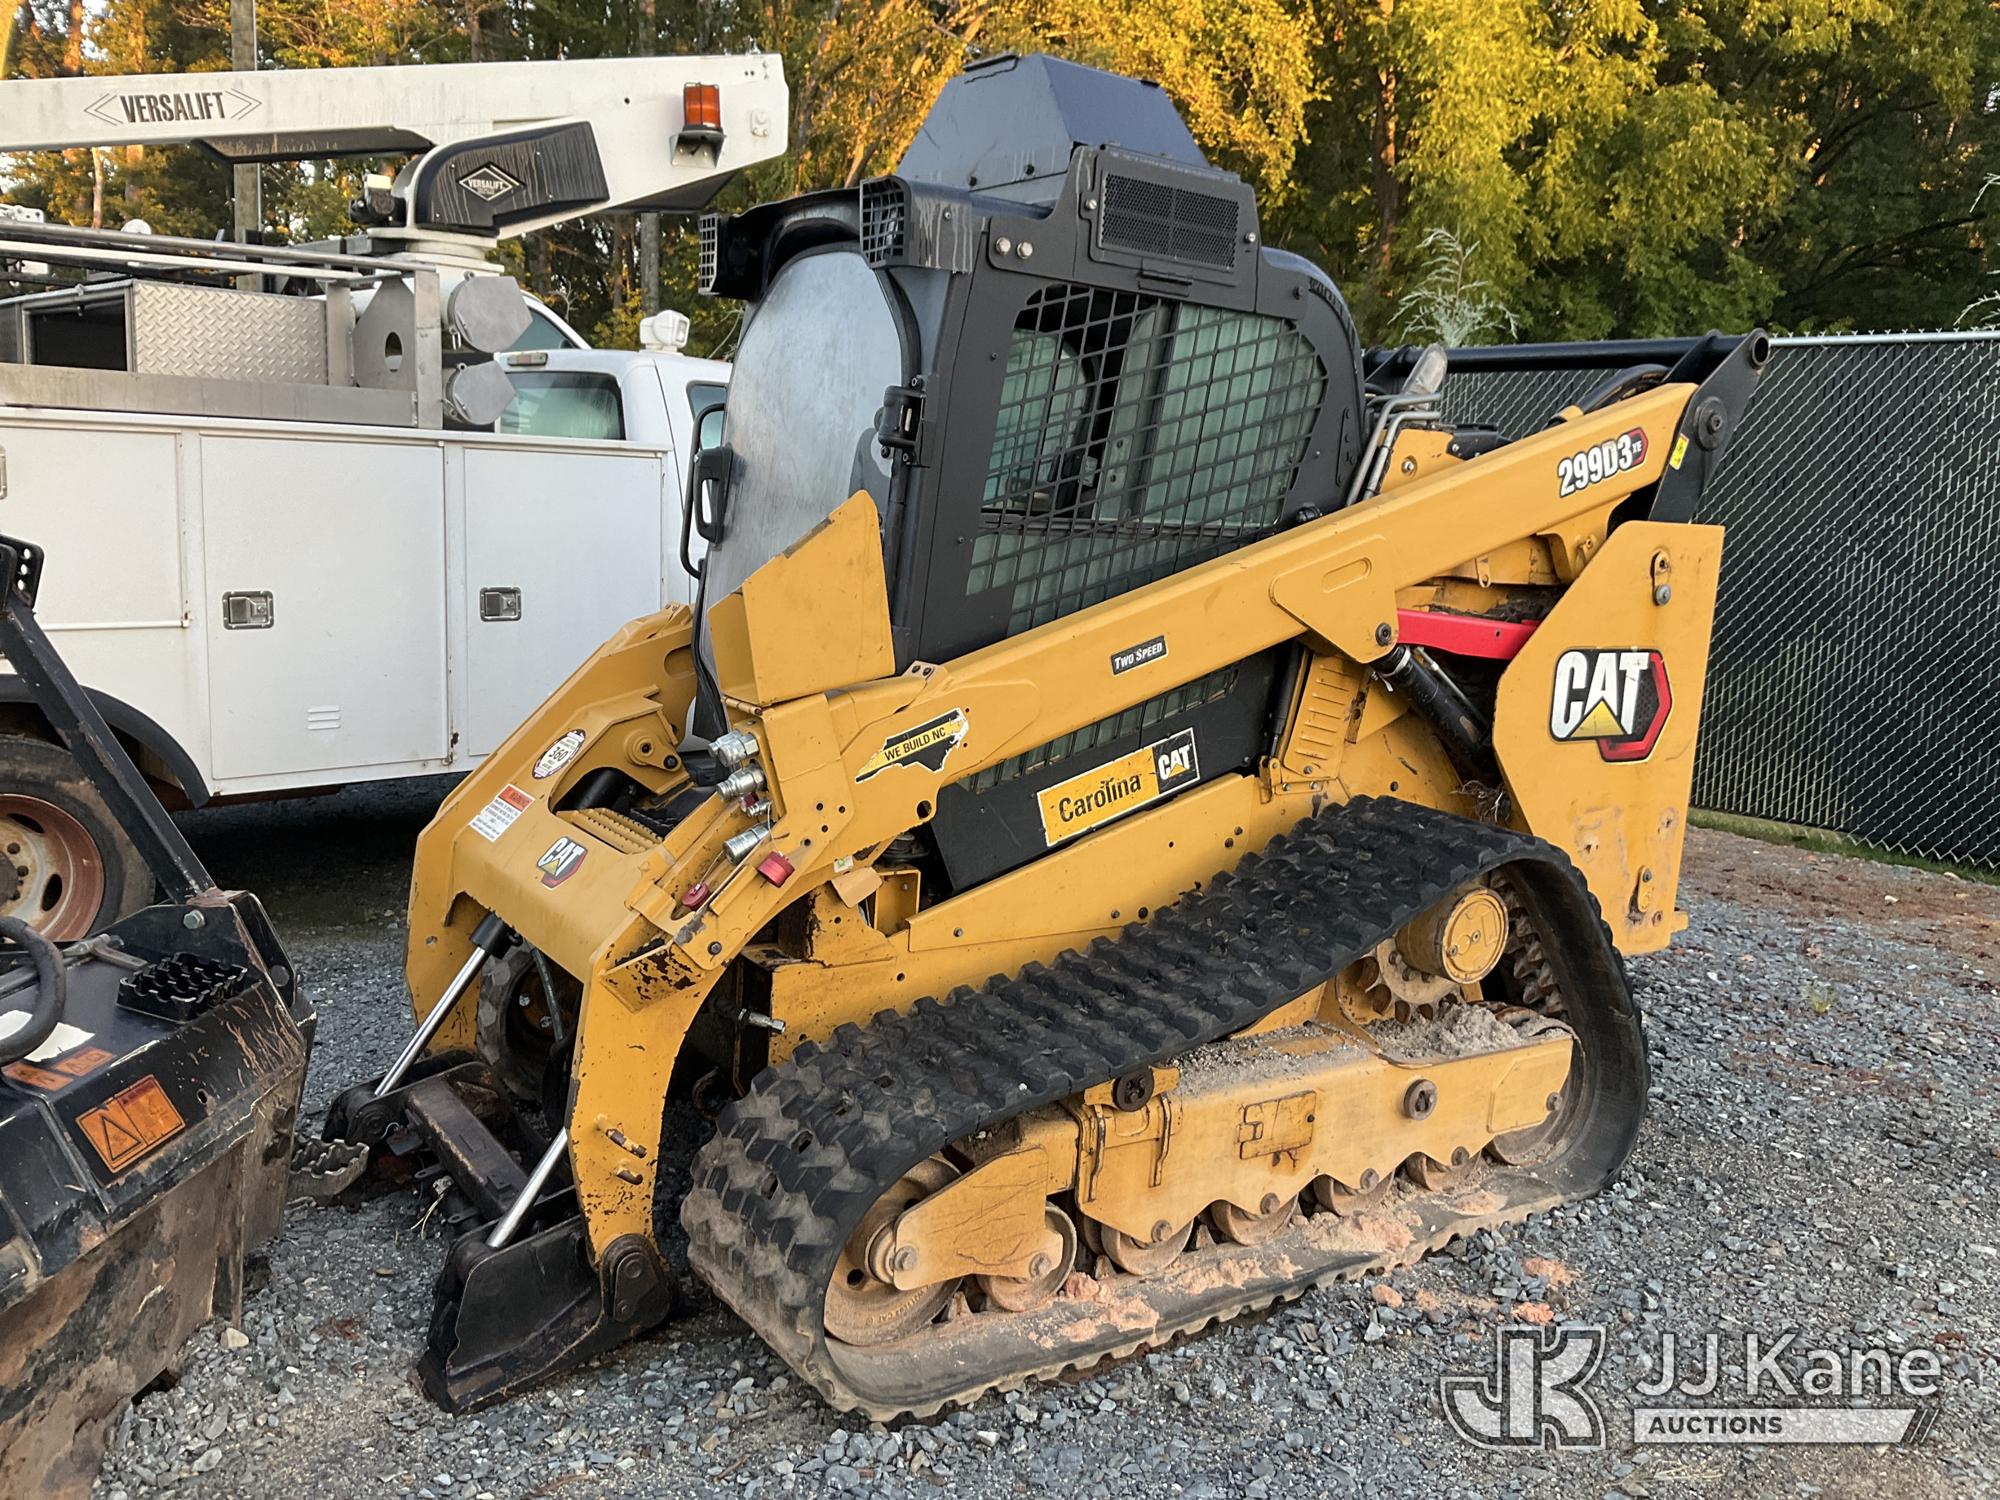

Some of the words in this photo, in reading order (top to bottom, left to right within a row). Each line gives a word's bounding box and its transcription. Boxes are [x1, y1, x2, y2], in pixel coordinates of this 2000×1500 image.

[119, 91, 225, 123] VERSALIFT
[468, 178, 504, 190] VERSALIFT
[1558, 434, 1633, 497] 299D3
[1551, 650, 1650, 739] CAT
[884, 747, 901, 761] WE
[903, 734, 930, 753] BUILD
[932, 727, 946, 741] NC
[1058, 774, 1142, 823] Carolina
[1158, 744, 1191, 780] CAT
[537, 837, 585, 877] CAT
